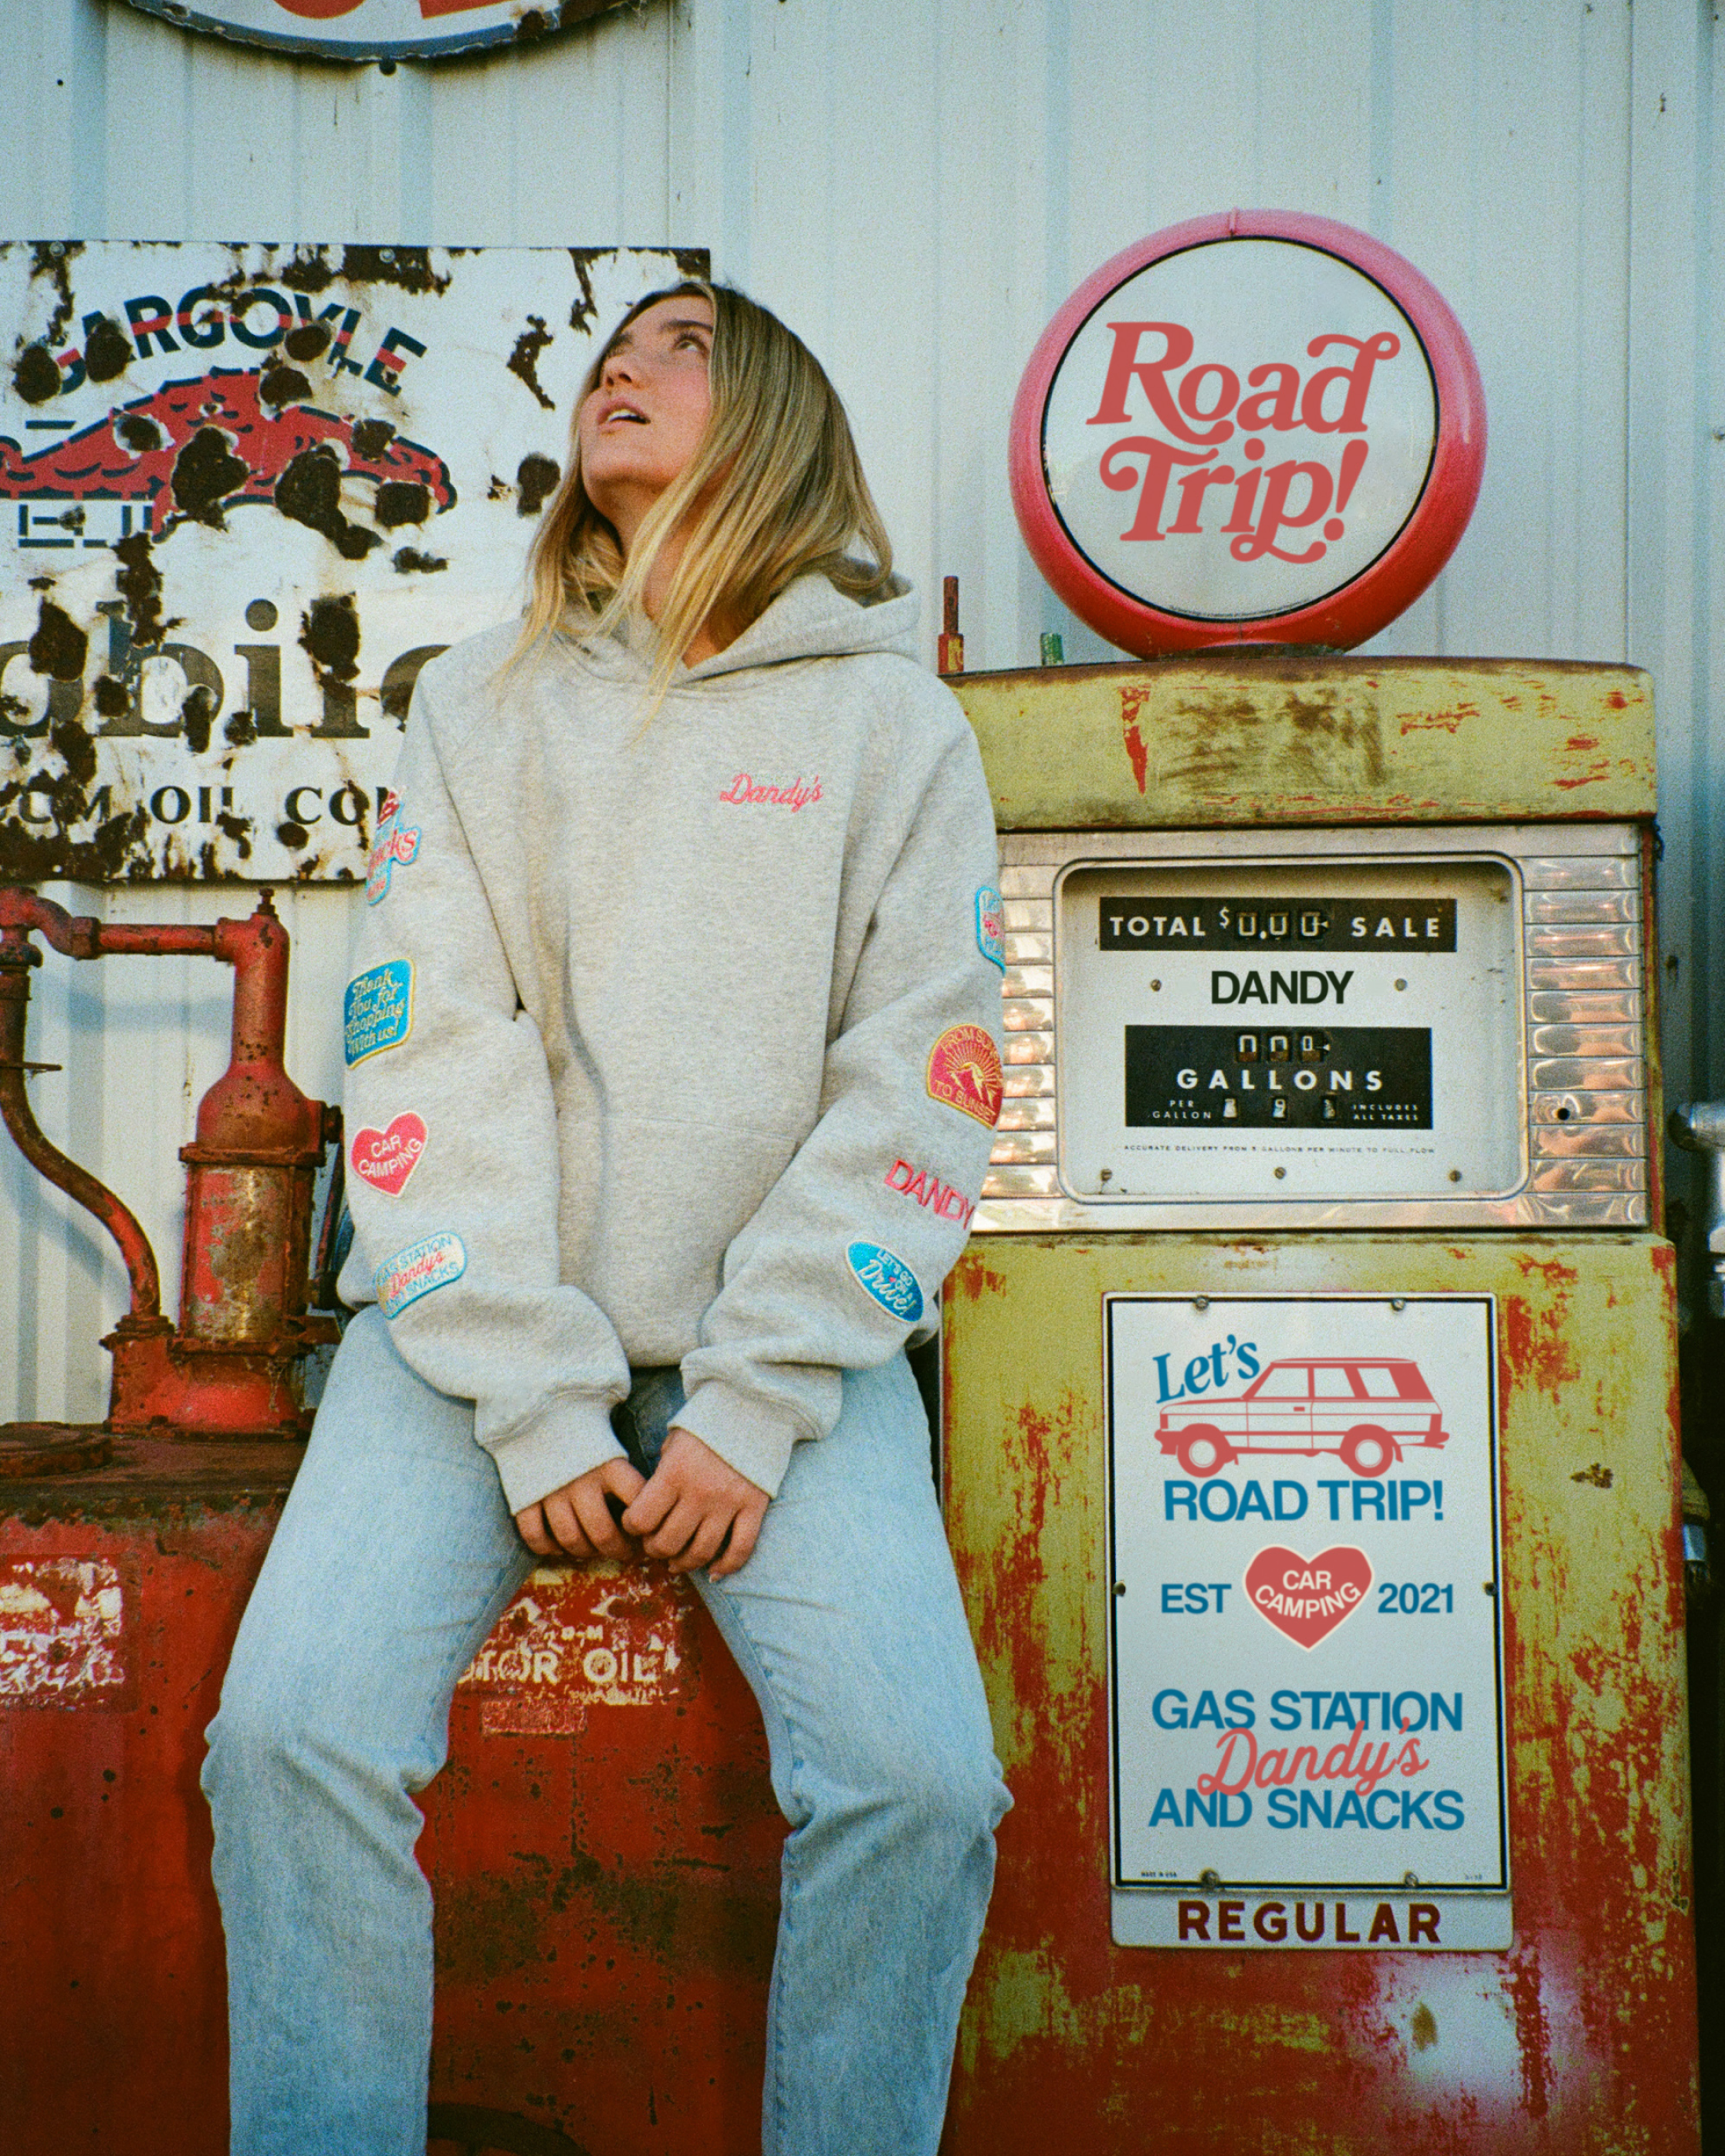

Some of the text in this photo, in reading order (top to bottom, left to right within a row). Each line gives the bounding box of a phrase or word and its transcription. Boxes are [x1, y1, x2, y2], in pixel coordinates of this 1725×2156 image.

[1086, 321, 1401, 445] Road
[1099, 435, 1369, 564] Trip!
[719, 773, 824, 813] Dandy's
[1109, 916, 1206, 936] TOTAL
[1351, 917, 1441, 938] SALE
[352, 968, 404, 1000] Thank
[1210, 970, 1355, 1005] DANDY
[934, 1079, 953, 1097] TO
[1176, 1068, 1383, 1092] GALLONS
[1152, 1110, 1213, 1120] GALLON
[1169, 1099, 1195, 1108] PER
[1352, 1104, 1419, 1112] INCLUDES
[1380, 1113, 1419, 1122] TAXES
[357, 1138, 424, 1180] CAMPING
[370, 1135, 402, 1158] CAR
[884, 1158, 976, 1230] DANDY
[376, 1235, 452, 1287] GAS STATION
[405, 1261, 459, 1297] SNACKS
[856, 1258, 917, 1316] Drive!
[1152, 1334, 1261, 1404] Let's
[1163, 1479, 1444, 1521] ROAD TRIP!
[1160, 1582, 1454, 1614] EST 2021
[1282, 1569, 1332, 1591] CAR
[1254, 1580, 1361, 1620] CAMPING
[583, 1647, 661, 1685] OIL
[1152, 1688, 1463, 1731] GAS STATION
[1196, 1716, 1430, 1797] Dandy's
[1148, 1788, 1465, 1831] AND SNACKS
[1178, 1900, 1442, 1944] REGULAR
